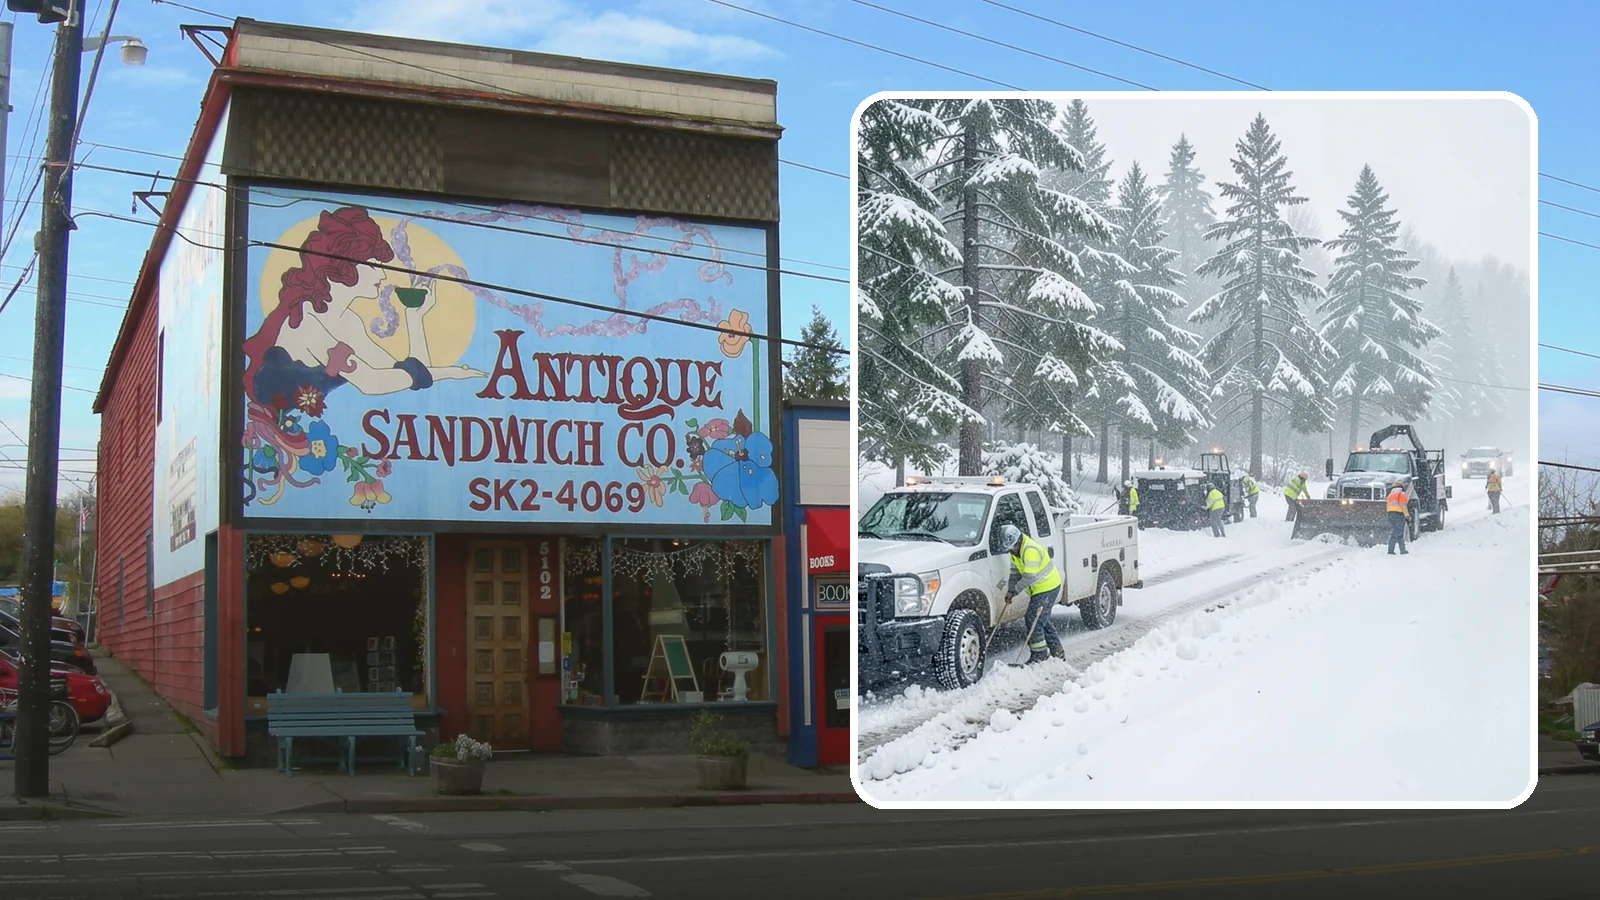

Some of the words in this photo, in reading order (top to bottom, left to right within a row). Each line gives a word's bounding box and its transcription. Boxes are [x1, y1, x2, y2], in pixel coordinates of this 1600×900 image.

[475, 329, 723, 421] ANTIQUE
[361, 408, 605, 467] SANDWICH
[616, 420, 686, 469] CO.
[468, 476, 646, 513] SK2-4069
[539, 541, 552, 600] 5102
[809, 555, 835, 569] BOOKS
